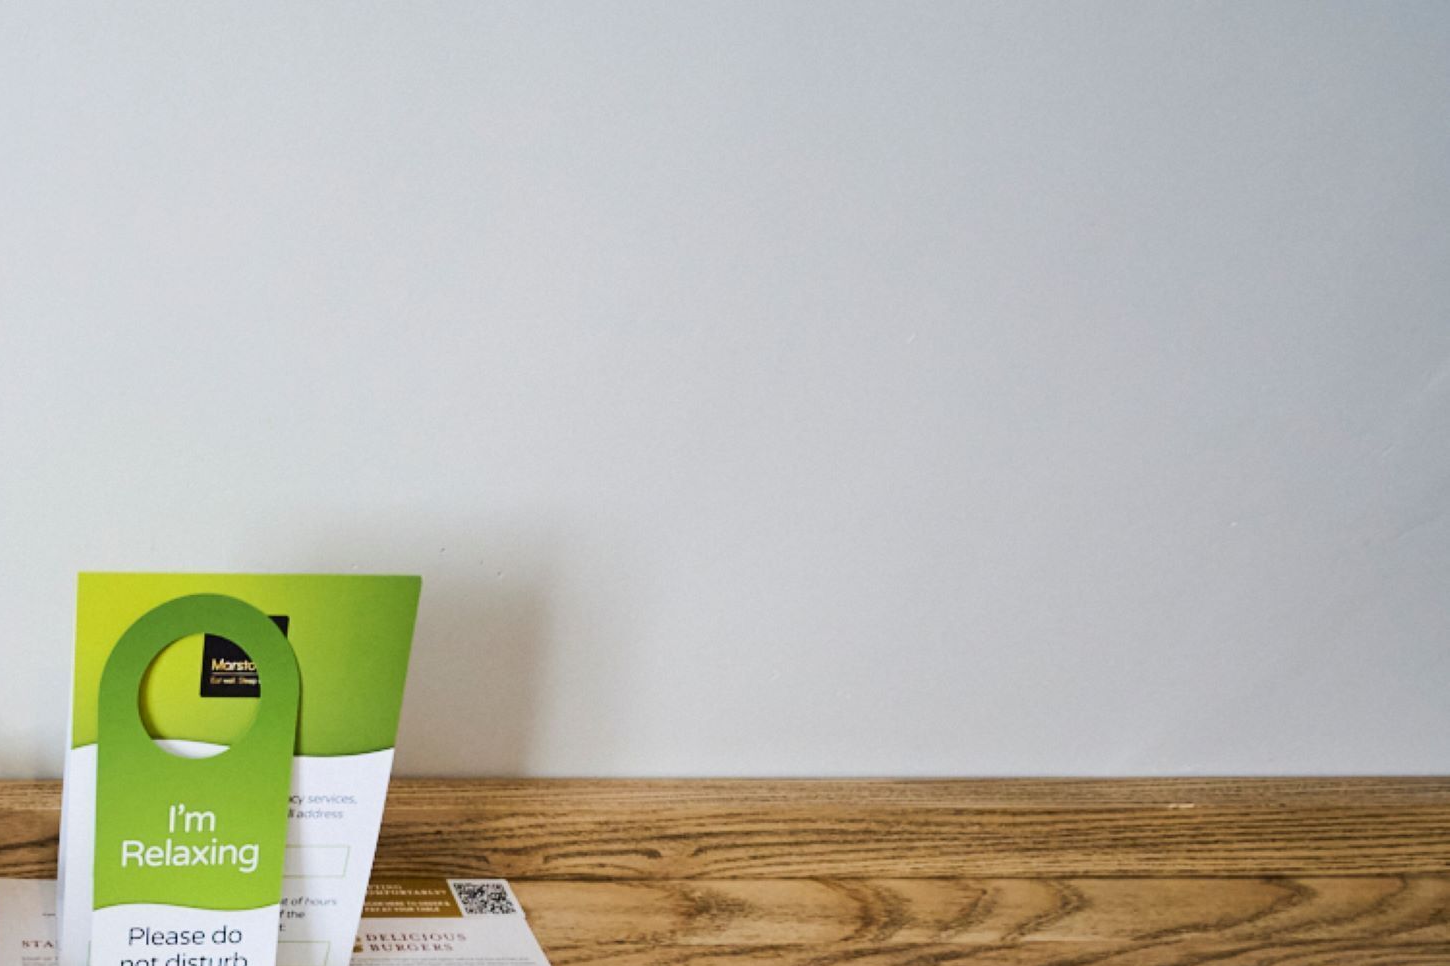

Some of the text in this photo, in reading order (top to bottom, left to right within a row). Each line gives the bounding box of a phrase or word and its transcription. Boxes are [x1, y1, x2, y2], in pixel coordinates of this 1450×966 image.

[296, 809, 344, 818] address
[121, 838, 260, 873] Relaxing
[287, 910, 306, 918] the
[128, 925, 243, 945] Please do
[365, 933, 467, 941] DELICIOUS
[370, 943, 454, 952] BURGERS
